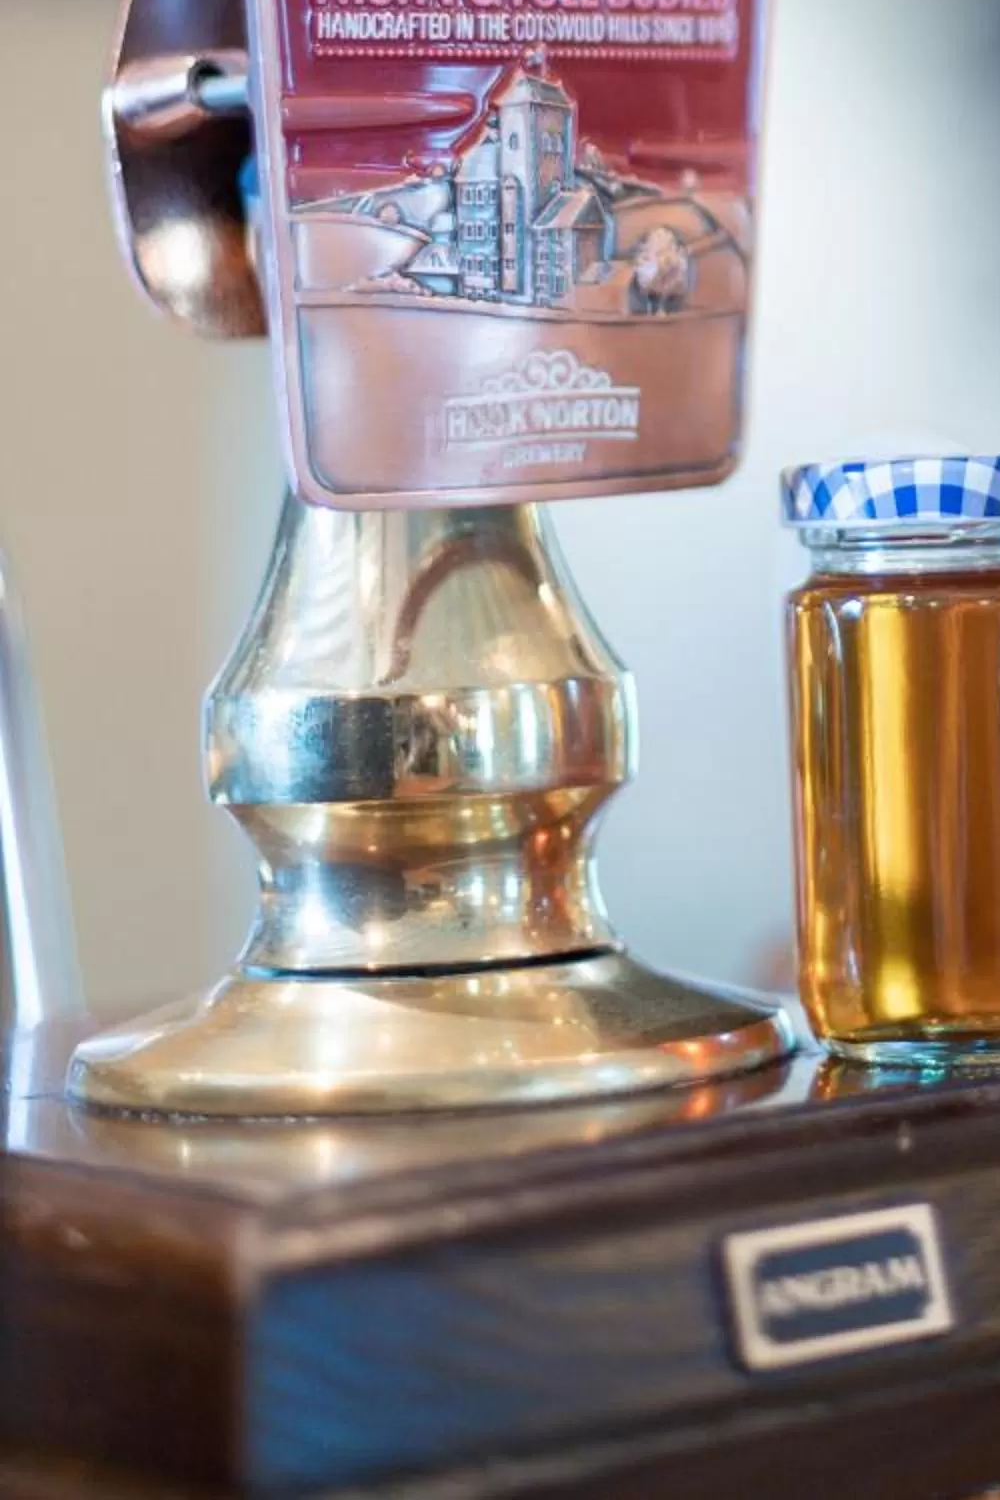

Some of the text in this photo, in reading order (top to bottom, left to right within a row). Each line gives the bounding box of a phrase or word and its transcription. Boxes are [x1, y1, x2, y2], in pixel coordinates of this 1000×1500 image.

[318, 11, 450, 41] HANDCRAFTED
[456, 12, 475, 41] IN
[478, 12, 510, 41] THE
[514, 12, 605, 42] COTSWOLD
